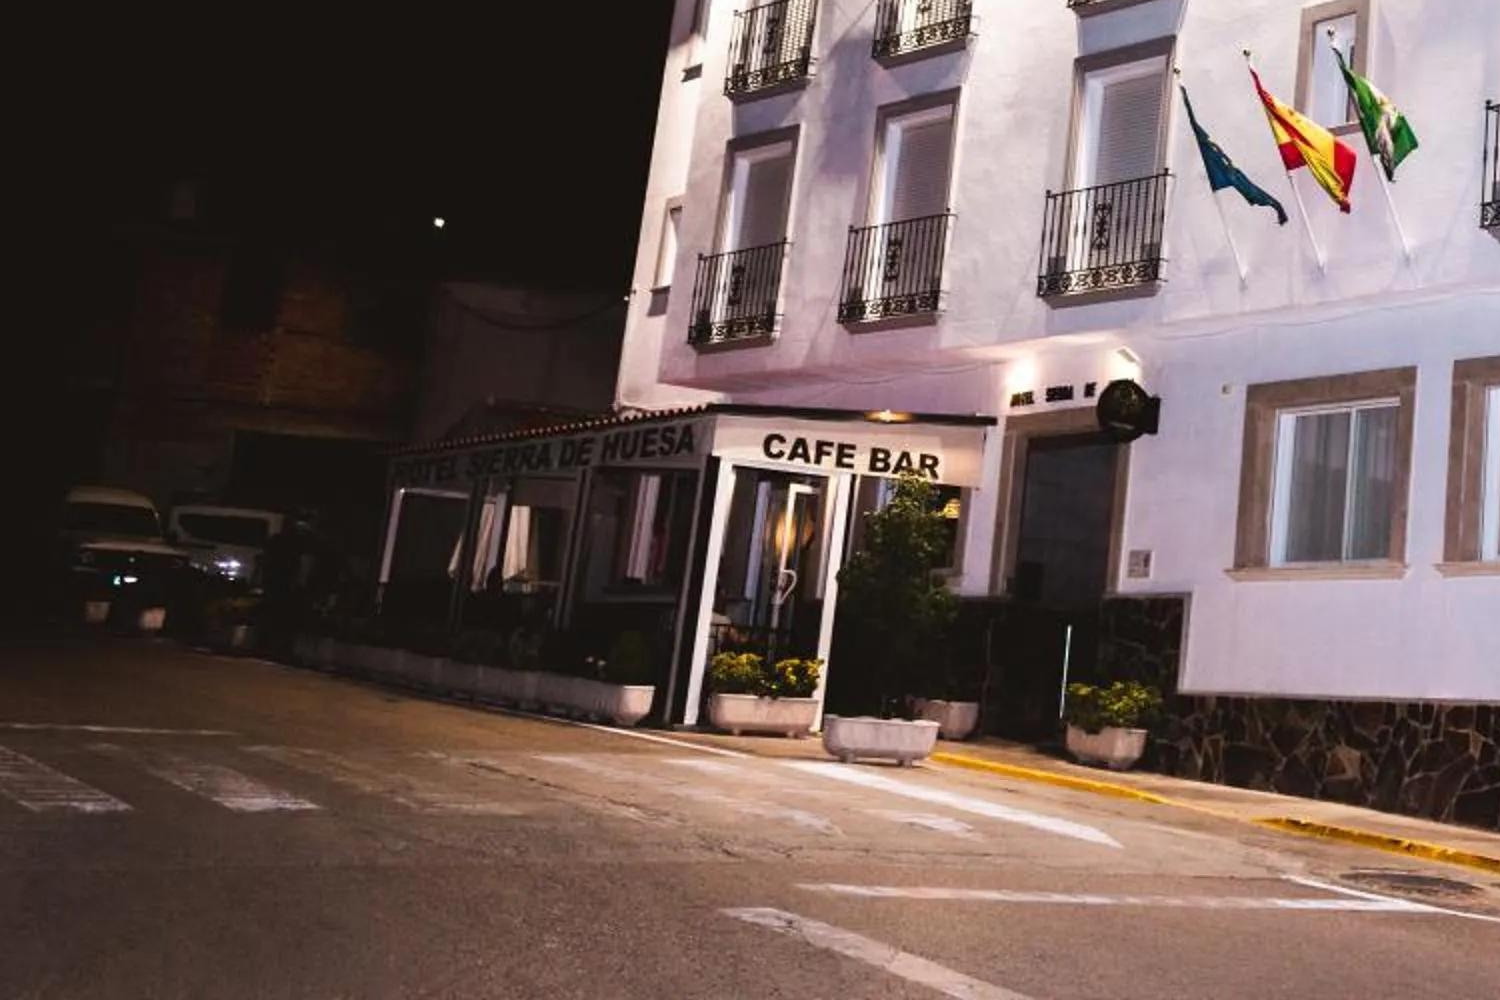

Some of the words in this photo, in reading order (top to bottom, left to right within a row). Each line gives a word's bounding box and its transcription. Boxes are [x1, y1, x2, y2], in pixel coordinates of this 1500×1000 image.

[467, 442, 551, 478] SIERRA
[559, 434, 595, 467] DE
[601, 424, 695, 463] HUESA
[763, 433, 857, 469] CAFE
[868, 447, 940, 480] BAR
